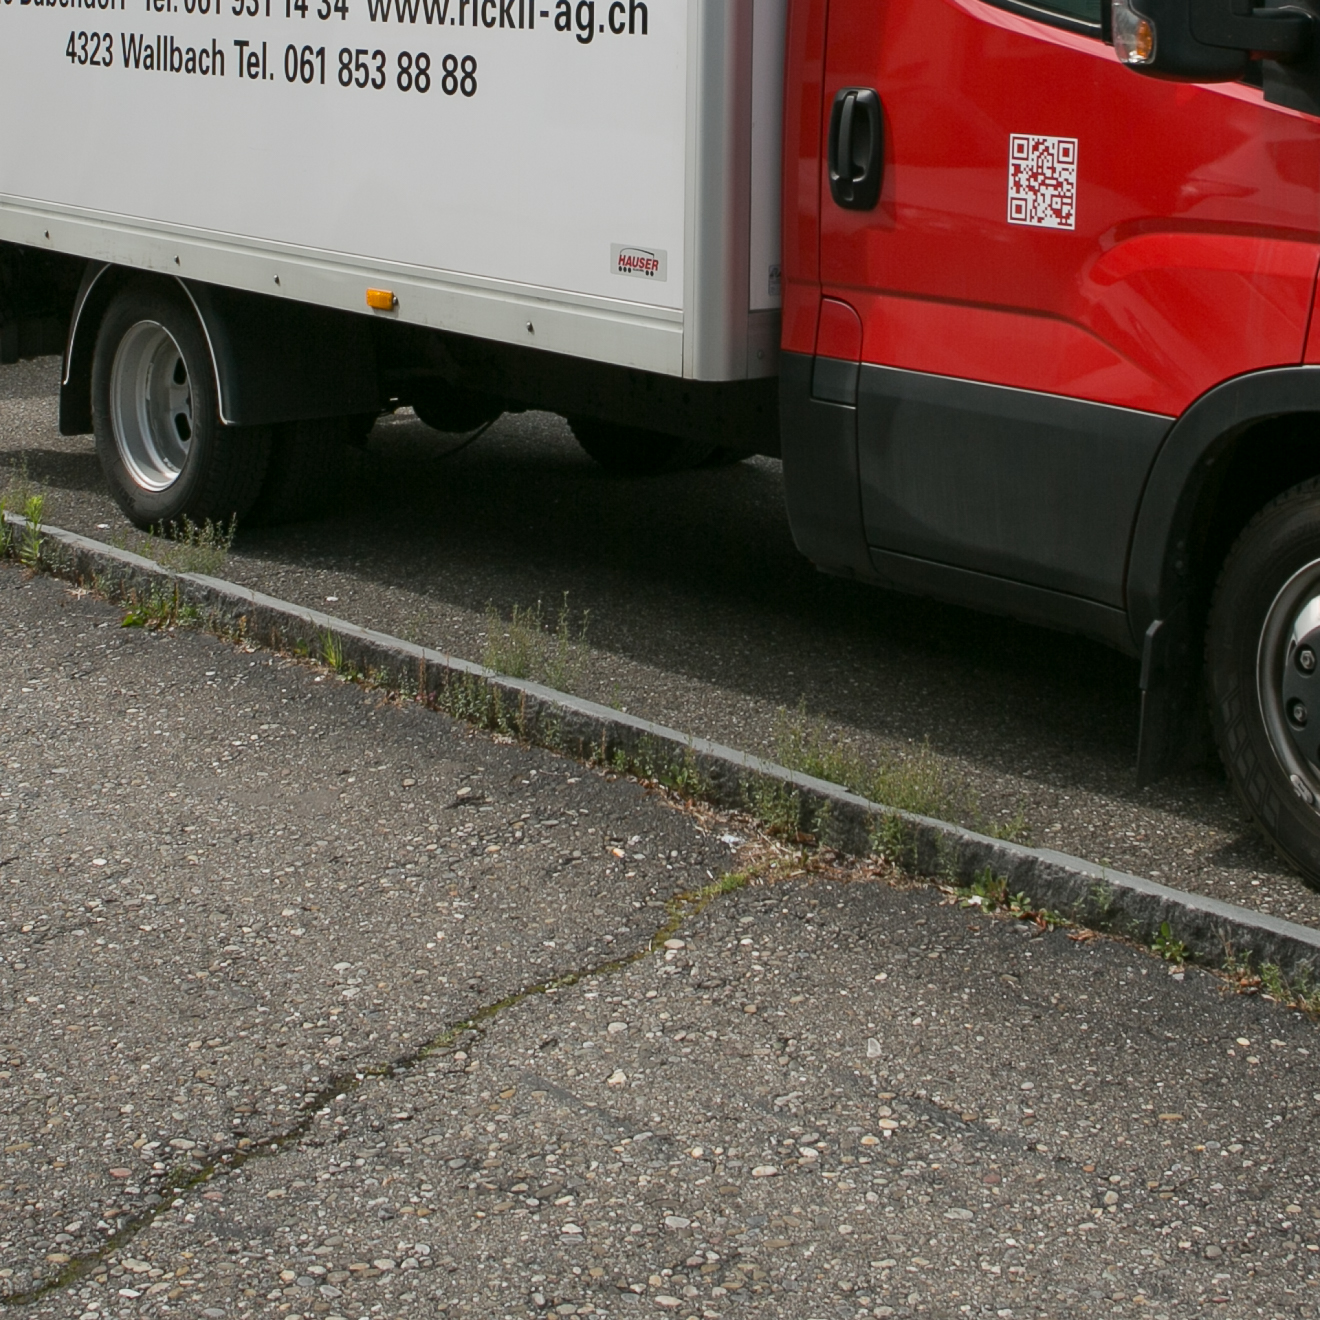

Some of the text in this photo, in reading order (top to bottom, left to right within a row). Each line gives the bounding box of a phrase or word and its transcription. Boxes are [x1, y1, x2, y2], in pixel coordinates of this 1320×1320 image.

[65, 30, 478, 98] 4323 Wallbach Tel. 061 853 88 88
[618, 254, 659, 272] HAUSER
